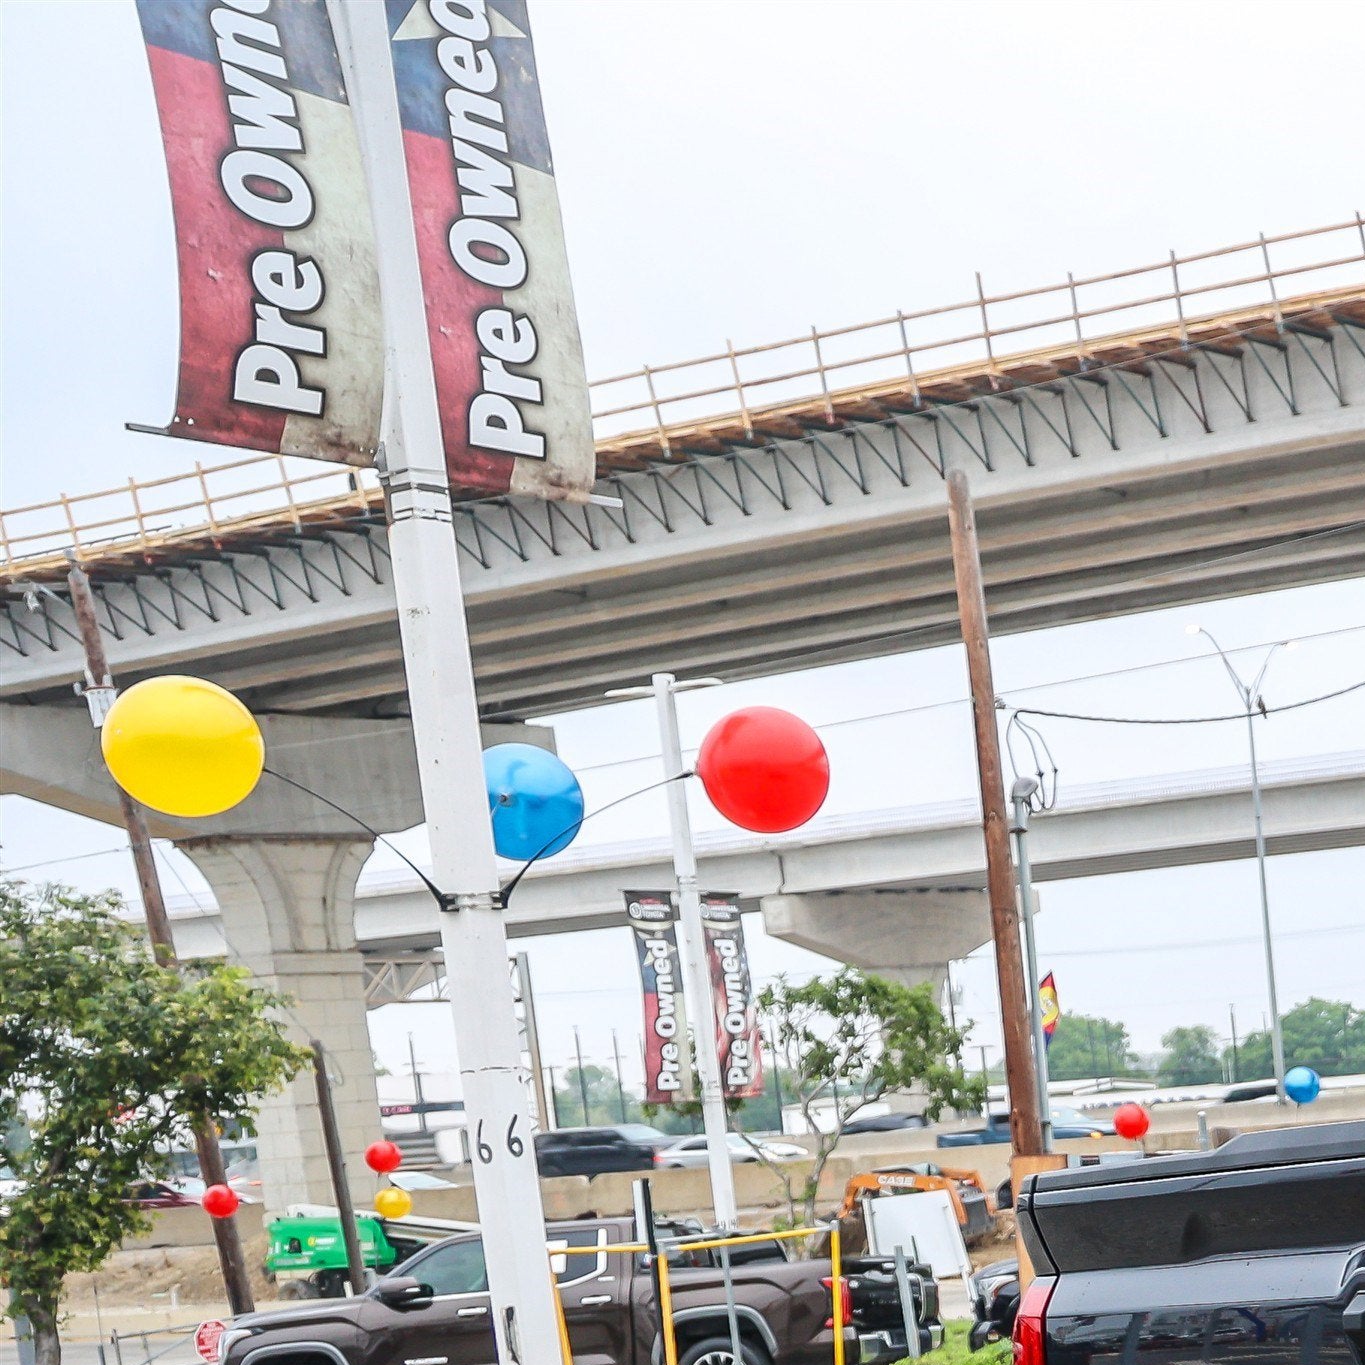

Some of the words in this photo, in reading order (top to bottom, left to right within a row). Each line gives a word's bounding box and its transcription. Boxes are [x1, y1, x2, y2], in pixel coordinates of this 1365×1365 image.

[210, 0, 315, 228] Own
[233, 250, 326, 416] Pre
[469, 308, 545, 458] Pre
[645, 939, 677, 1038] Owned
[713, 938, 746, 1034] Owned
[656, 1042, 681, 1091] Pre
[727, 1039, 750, 1086] Pre
